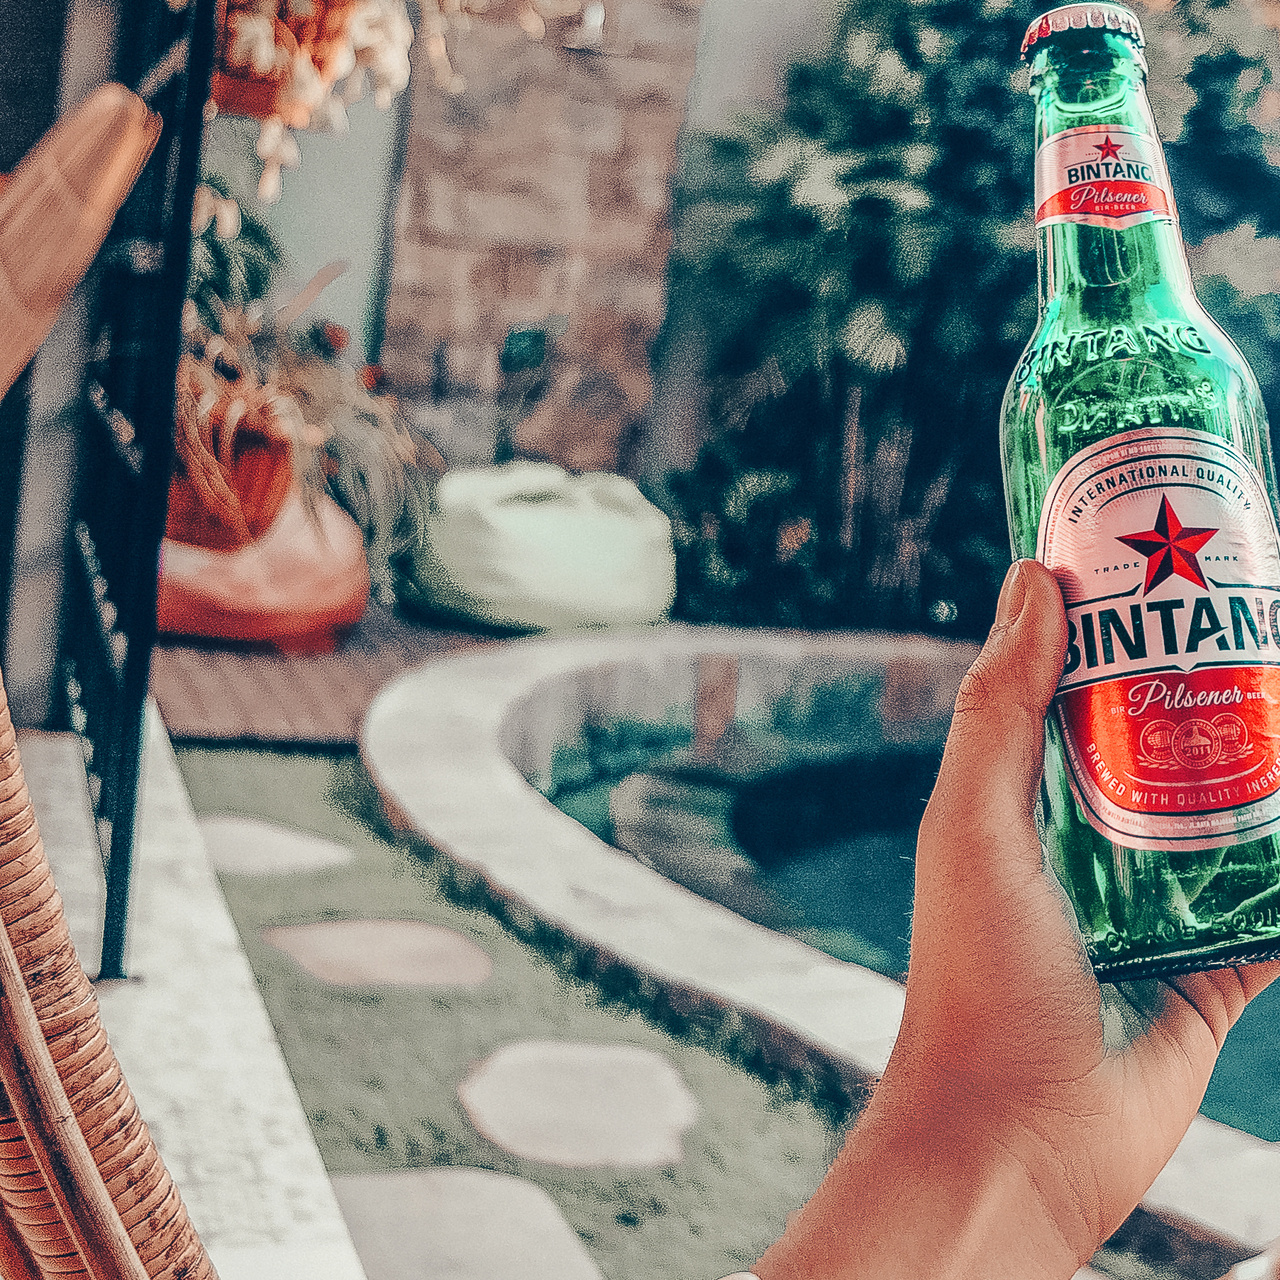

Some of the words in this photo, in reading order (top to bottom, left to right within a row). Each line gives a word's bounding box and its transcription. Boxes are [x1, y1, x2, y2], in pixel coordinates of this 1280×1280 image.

[1067, 162, 1152, 185] BINTANG
[1070, 186, 1148, 210] Pilsener
[1068, 464, 1189, 524] INTERNATIONAL
[1195, 466, 1251, 510] QUALITY
[1094, 561, 1141, 575] TRADE
[1111, 706, 1126, 715] BIR
[1128, 678, 1244, 716] Pilsener
[1246, 691, 1266, 700] BEER
[1185, 746, 1211, 757] 2011
[1086, 742, 1126, 797] BREWED
[1131, 789, 1169, 806] WITH
[1177, 787, 1241, 807] QUALITY
